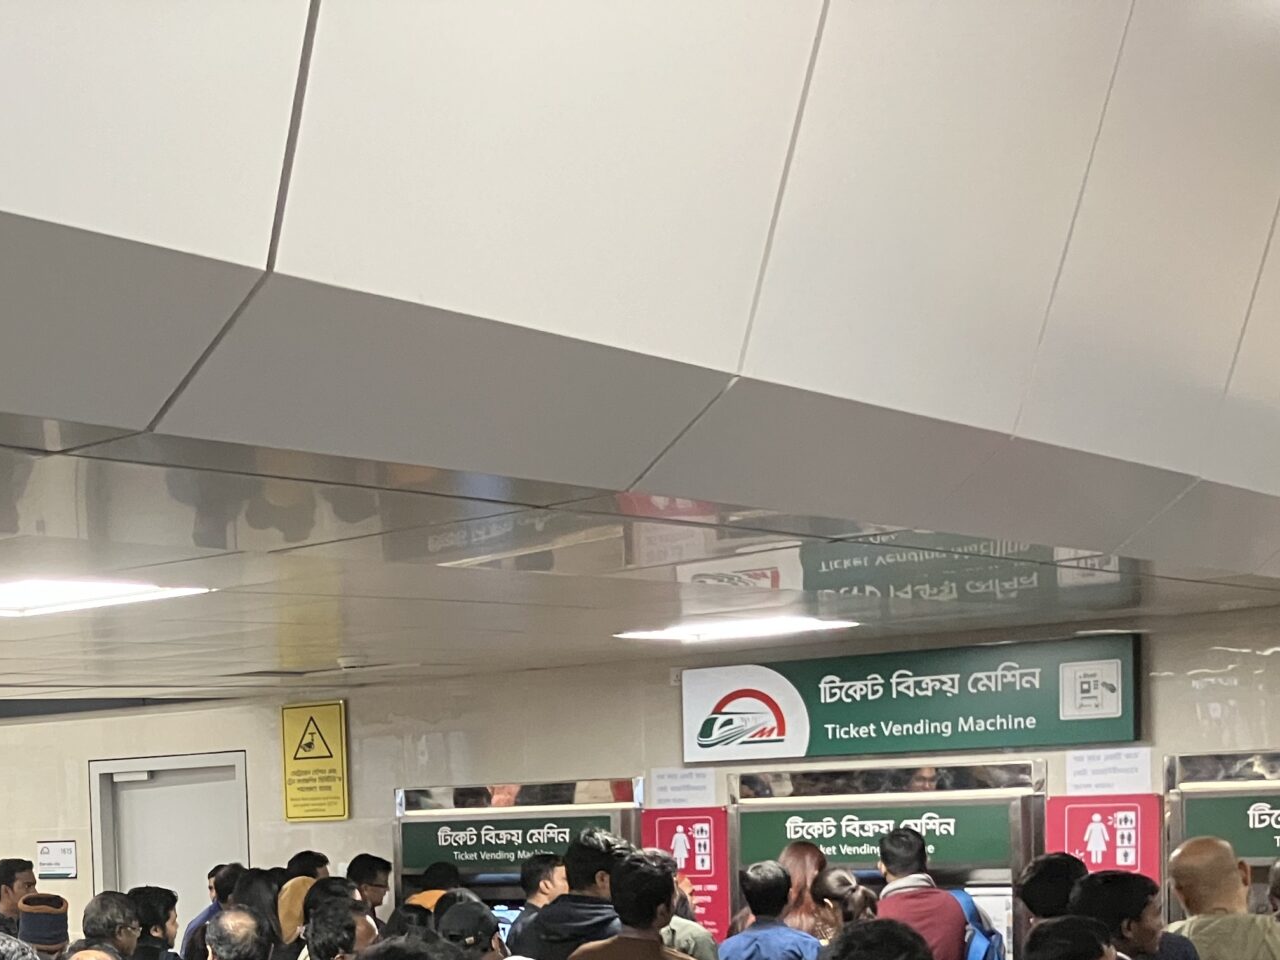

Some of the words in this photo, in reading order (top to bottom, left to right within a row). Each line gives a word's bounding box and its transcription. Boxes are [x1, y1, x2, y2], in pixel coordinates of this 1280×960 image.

[819, 674, 885, 703] টিকেট
[890, 670, 960, 698] বিক্রয়
[968, 662, 1041, 693] মেশিন
[824, 723, 876, 739] Ticket
[880, 719, 952, 737] Vending
[957, 714, 1037, 732] Machine
[437, 826, 477, 846] টিকেট
[480, 825, 522, 846] বিক্রয়
[526, 823, 570, 845] মেশিন
[785, 816, 837, 839] টিকেট
[453, 851, 478, 860] Ticket
[480, 850, 515, 861] Vending
